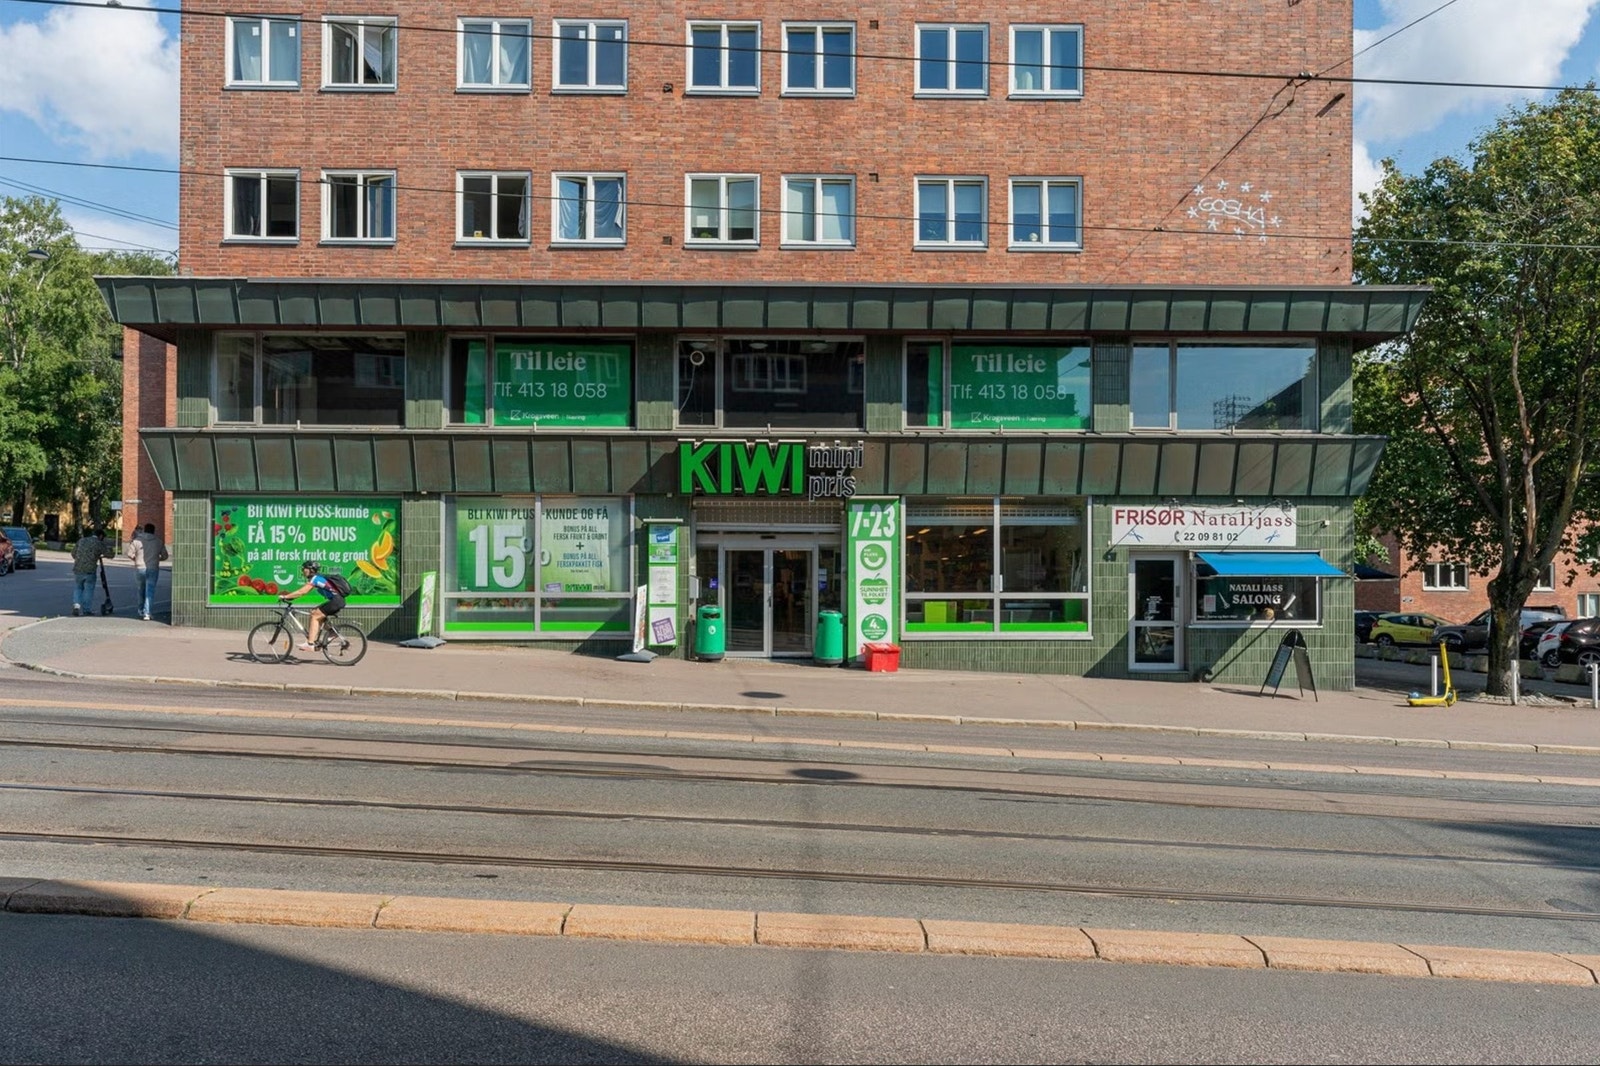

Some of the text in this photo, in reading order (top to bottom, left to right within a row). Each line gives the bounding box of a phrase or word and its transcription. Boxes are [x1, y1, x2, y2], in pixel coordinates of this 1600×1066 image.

[510, 351, 587, 371] Til leie
[971, 354, 1047, 373] Til leie
[493, 382, 607, 398] Tlf. 413 18 058
[950, 384, 1067, 400] Tlf. 413 18 058
[522, 412, 560, 421] Krogsveen
[983, 414, 1020, 423] Krogsveen
[679, 440, 864, 494] KIWI mini
[809, 471, 857, 502] pris
[247, 503, 370, 518] Bli KIWI PLUSS-kunde
[467, 508, 483, 520] BLI
[486, 508, 508, 520] KIWI
[581, 508, 594, 520] OG
[597, 505, 609, 520] FÅ
[1114, 509, 1185, 526] FRISØR
[581, 524, 587, 532] PÅ
[851, 504, 896, 538] 7-23
[247, 520, 266, 543] FÅ
[312, 526, 357, 541] BONUS
[1183, 532, 1239, 541] 22 09 81 02
[247, 549, 259, 563] på
[261, 549, 274, 561] all
[276, 549, 301, 561] fersk
[302, 549, 327, 562] frukt
[329, 552, 341, 563] og
[1229, 584, 1283, 592] NATALI JASS
[1232, 594, 1281, 605] SALONG
